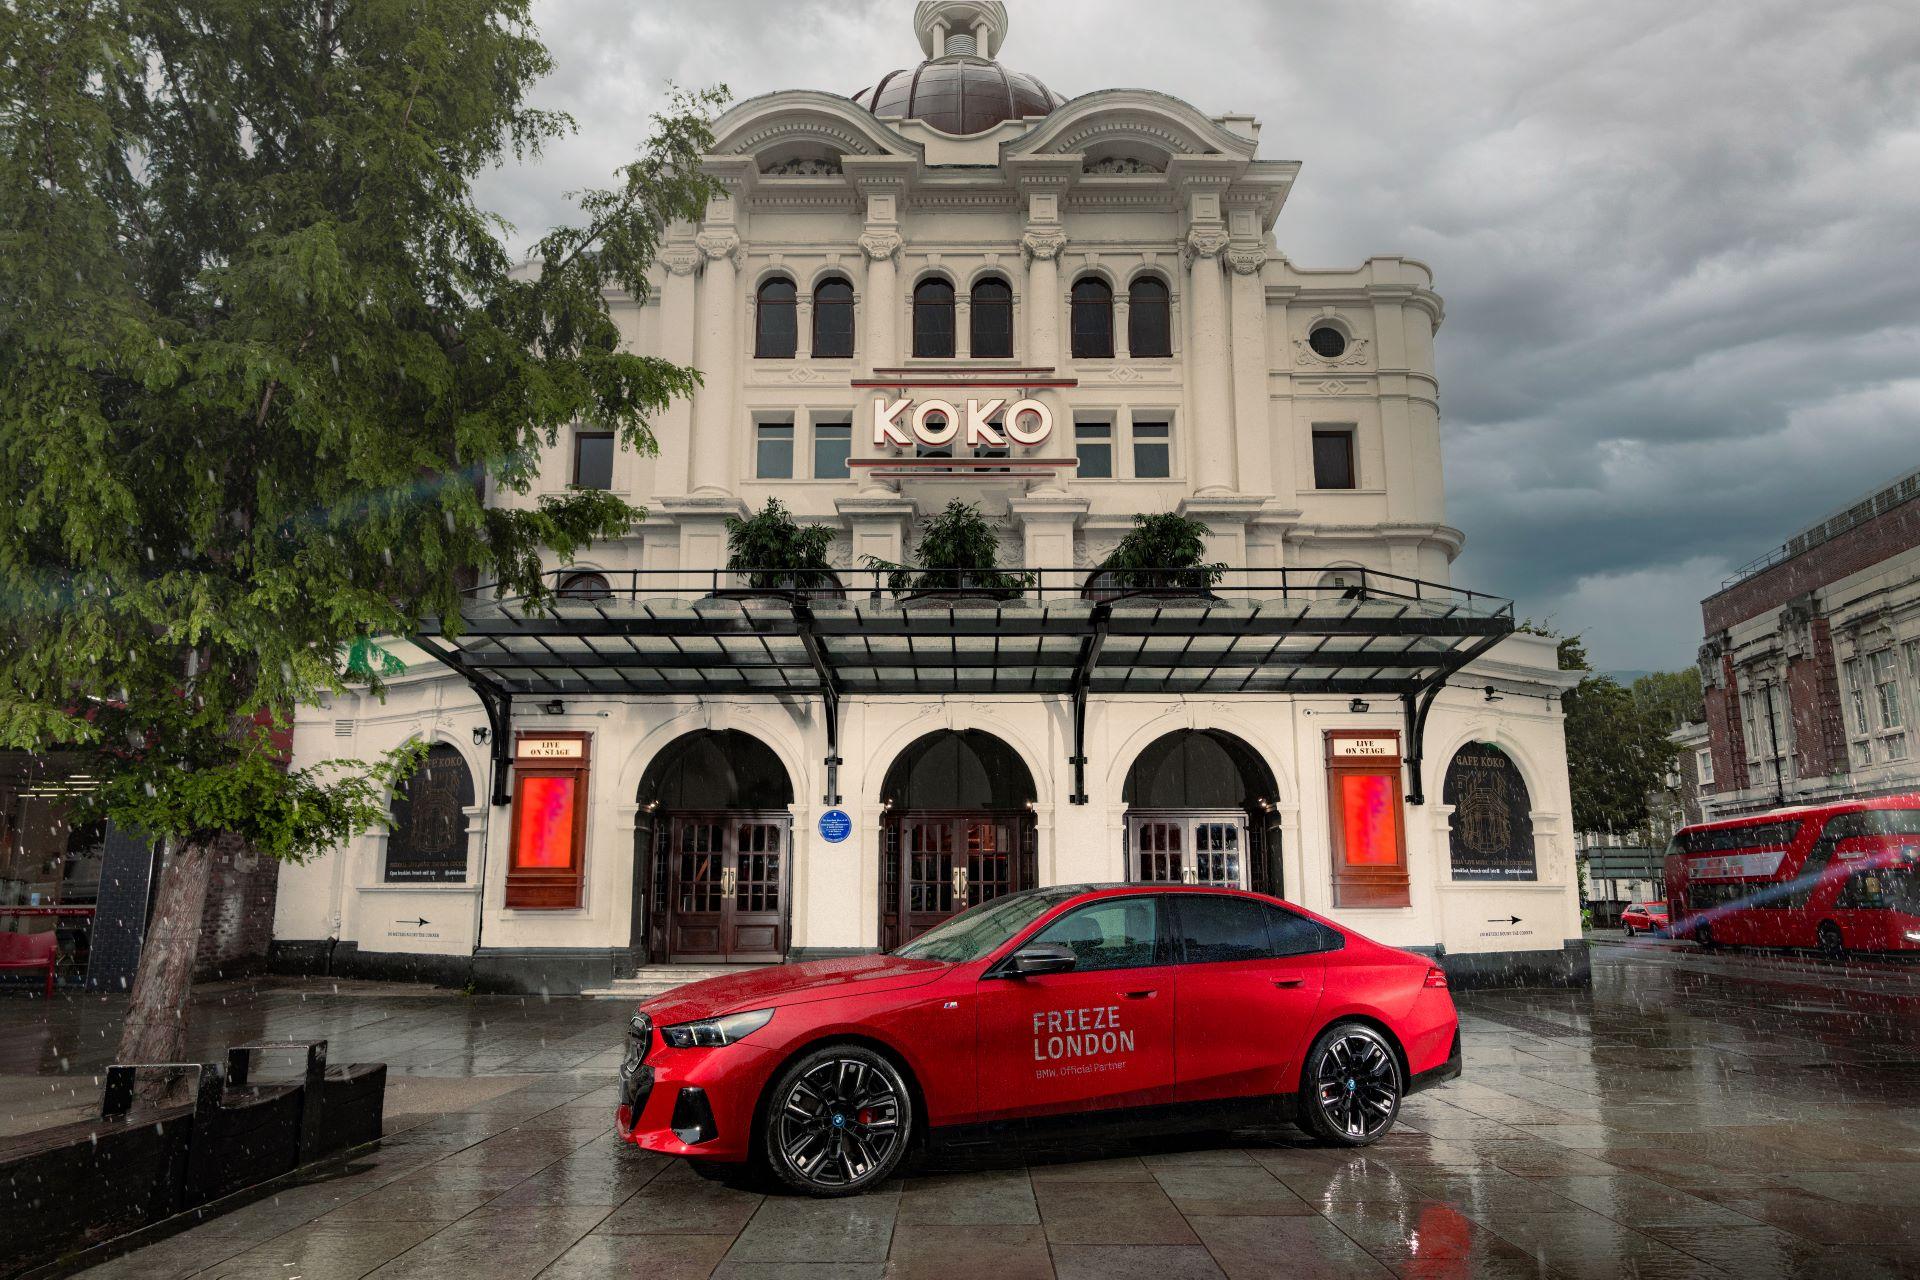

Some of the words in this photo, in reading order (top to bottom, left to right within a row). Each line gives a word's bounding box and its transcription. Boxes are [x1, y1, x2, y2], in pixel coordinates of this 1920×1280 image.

[873, 398, 1053, 448] KOKO
[541, 741, 560, 749] LIVE
[1345, 747, 1357, 755] ON
[1359, 747, 1385, 755] STAGE
[1481, 756, 1505, 768] KOKO
[1033, 1005, 1120, 1034] FRIEZE
[1034, 1029, 1135, 1061] LONDON
[1060, 1063, 1093, 1076] Official
[1094, 1061, 1127, 1072] Partner
